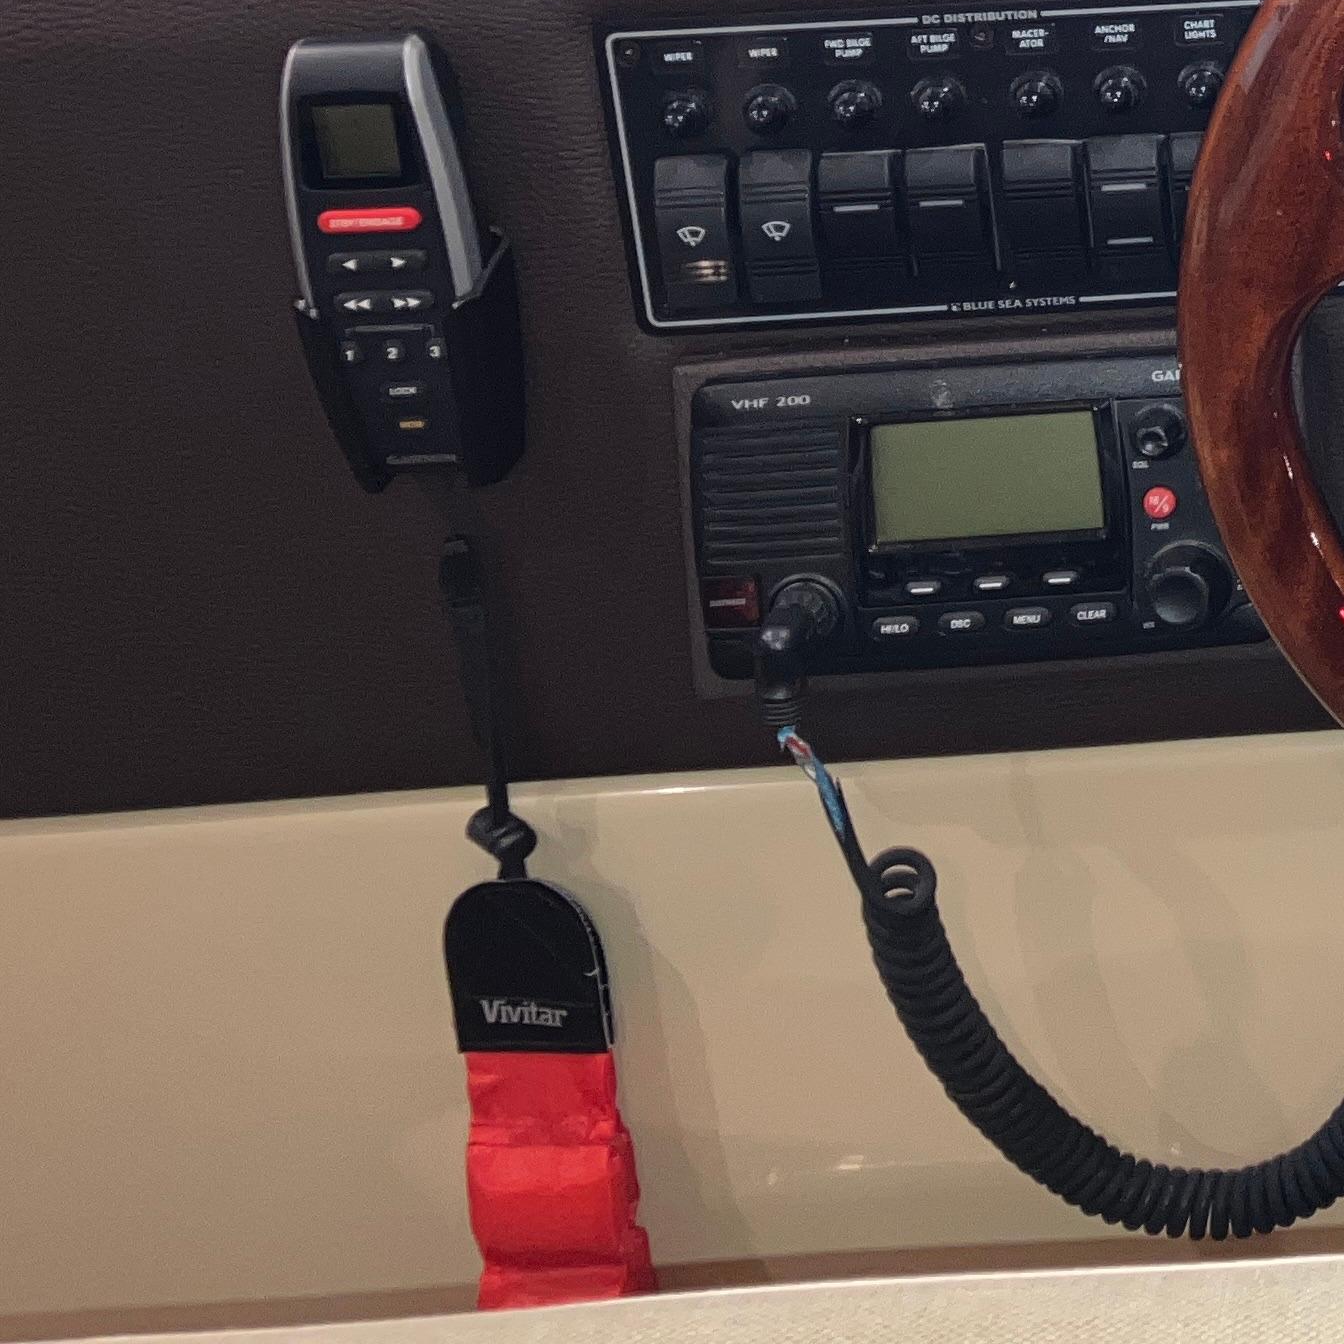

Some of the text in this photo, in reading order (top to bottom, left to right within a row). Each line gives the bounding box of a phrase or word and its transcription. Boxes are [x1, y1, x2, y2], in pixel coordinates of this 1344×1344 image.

[921, 10, 1038, 25] DC DISTRIBUTION
[1094, 23, 1136, 35] ANCHOR
[1184, 19, 1216, 30] CHART
[910, 34, 929, 44] AFT
[1184, 29, 1218, 40] LIGHTS
[920, 43, 949, 54] PUMP
[1019, 38, 1045, 49] ATOR
[834, 48, 863, 58] PUMP
[962, 295, 1077, 311] BLUE SEA SYSTEMS
[345, 345, 441, 361] 1 2 3
[731, 394, 811, 410] VHF 200
[1012, 614, 1042, 625] MENU
[1076, 609, 1108, 621] CLEAR
[950, 618, 972, 629] DSC
[479, 998, 569, 1028] Vivitar
